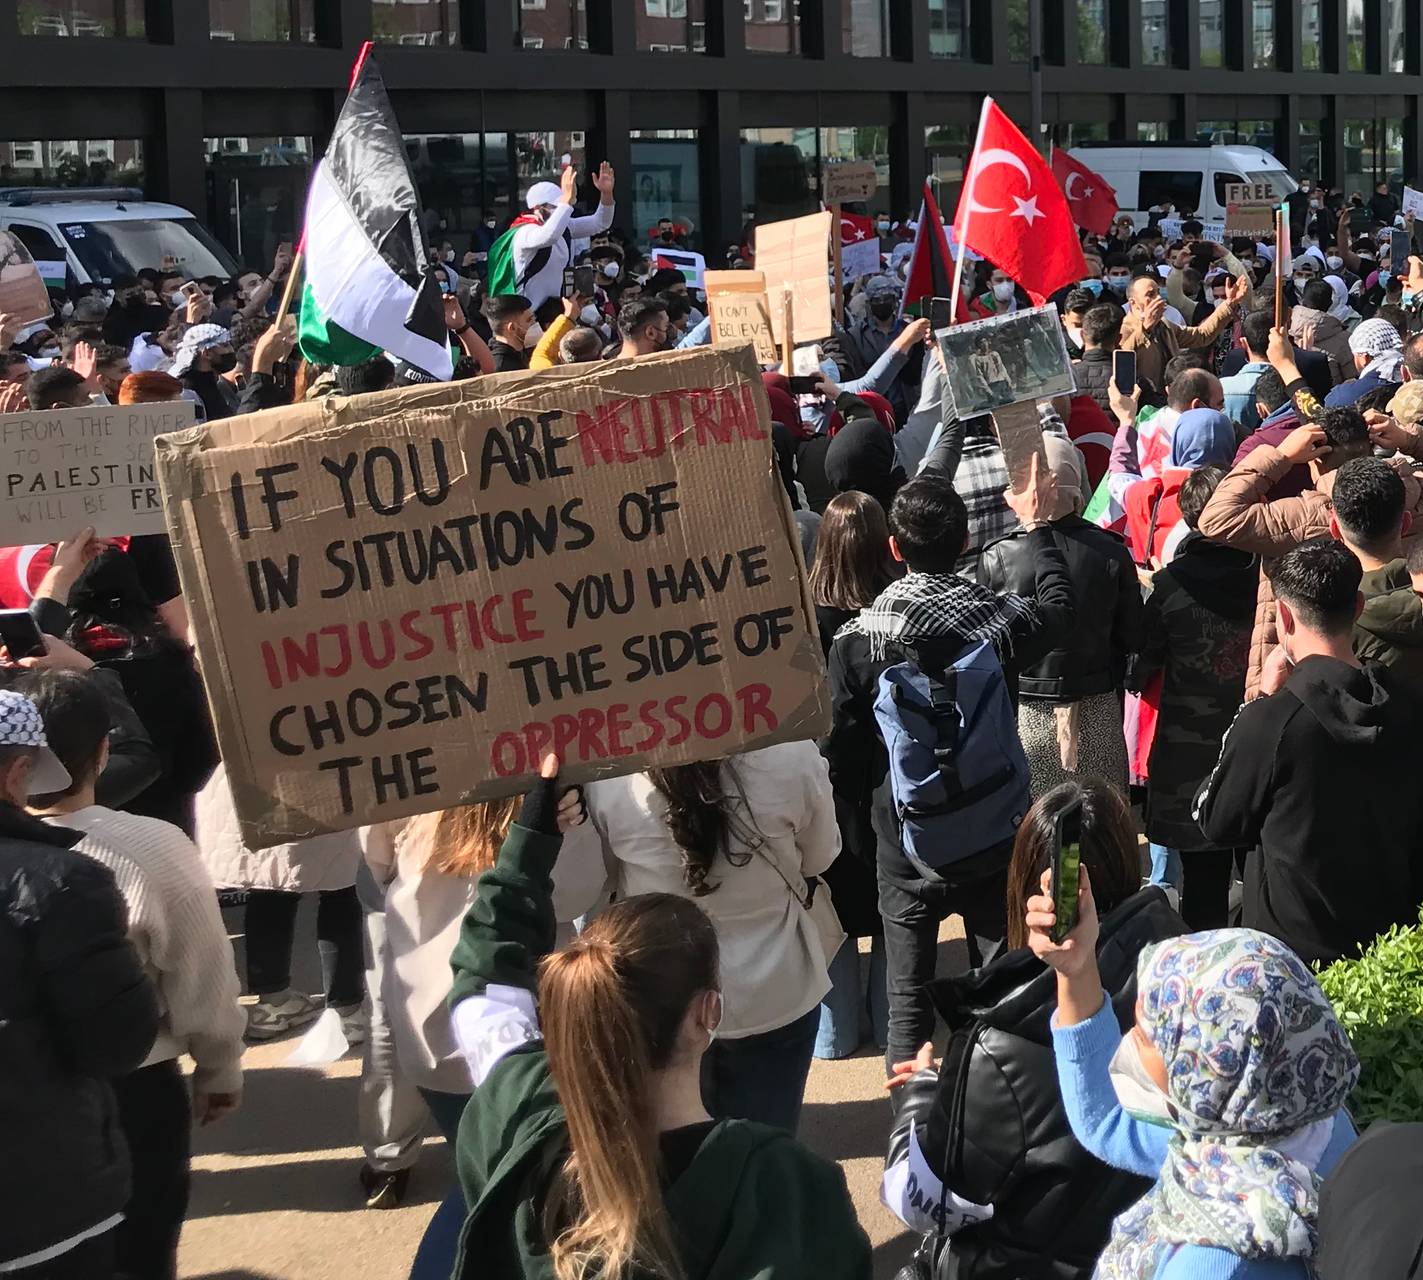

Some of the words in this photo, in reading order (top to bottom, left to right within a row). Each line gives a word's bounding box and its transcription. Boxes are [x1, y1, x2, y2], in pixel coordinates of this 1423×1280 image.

[1230, 184, 1273, 200] FREE
[718, 322, 769, 337] BELIEVE
[3, 419, 64, 443] FROM
[75, 415, 114, 436] THE
[128, 414, 186, 436] RIVER
[14, 450, 40, 465] TO
[56, 441, 103, 459] THE
[127, 443, 154, 462] SE
[231, 462, 298, 539] IF
[320, 438, 449, 518] YOU
[480, 409, 574, 490] ARE
[576, 385, 768, 467] NEUTRAL
[8, 464, 154, 496] PALESTIN
[16, 501, 68, 523] WILL
[83, 494, 108, 514] BE
[131, 488, 162, 510] FR
[248, 553, 299, 613] IN
[321, 498, 595, 598] SITUATIONS
[618, 481, 680, 542] OF
[261, 589, 545, 689] INJUSTICE
[555, 569, 635, 628] YOU
[647, 545, 771, 608] HAVE
[269, 672, 489, 756] CHOSEN
[509, 644, 612, 707] THE
[622, 622, 723, 682] SIDE
[734, 606, 795, 657] OF
[318, 747, 440, 815] THE
[491, 683, 778, 777] OPPRESSOR
